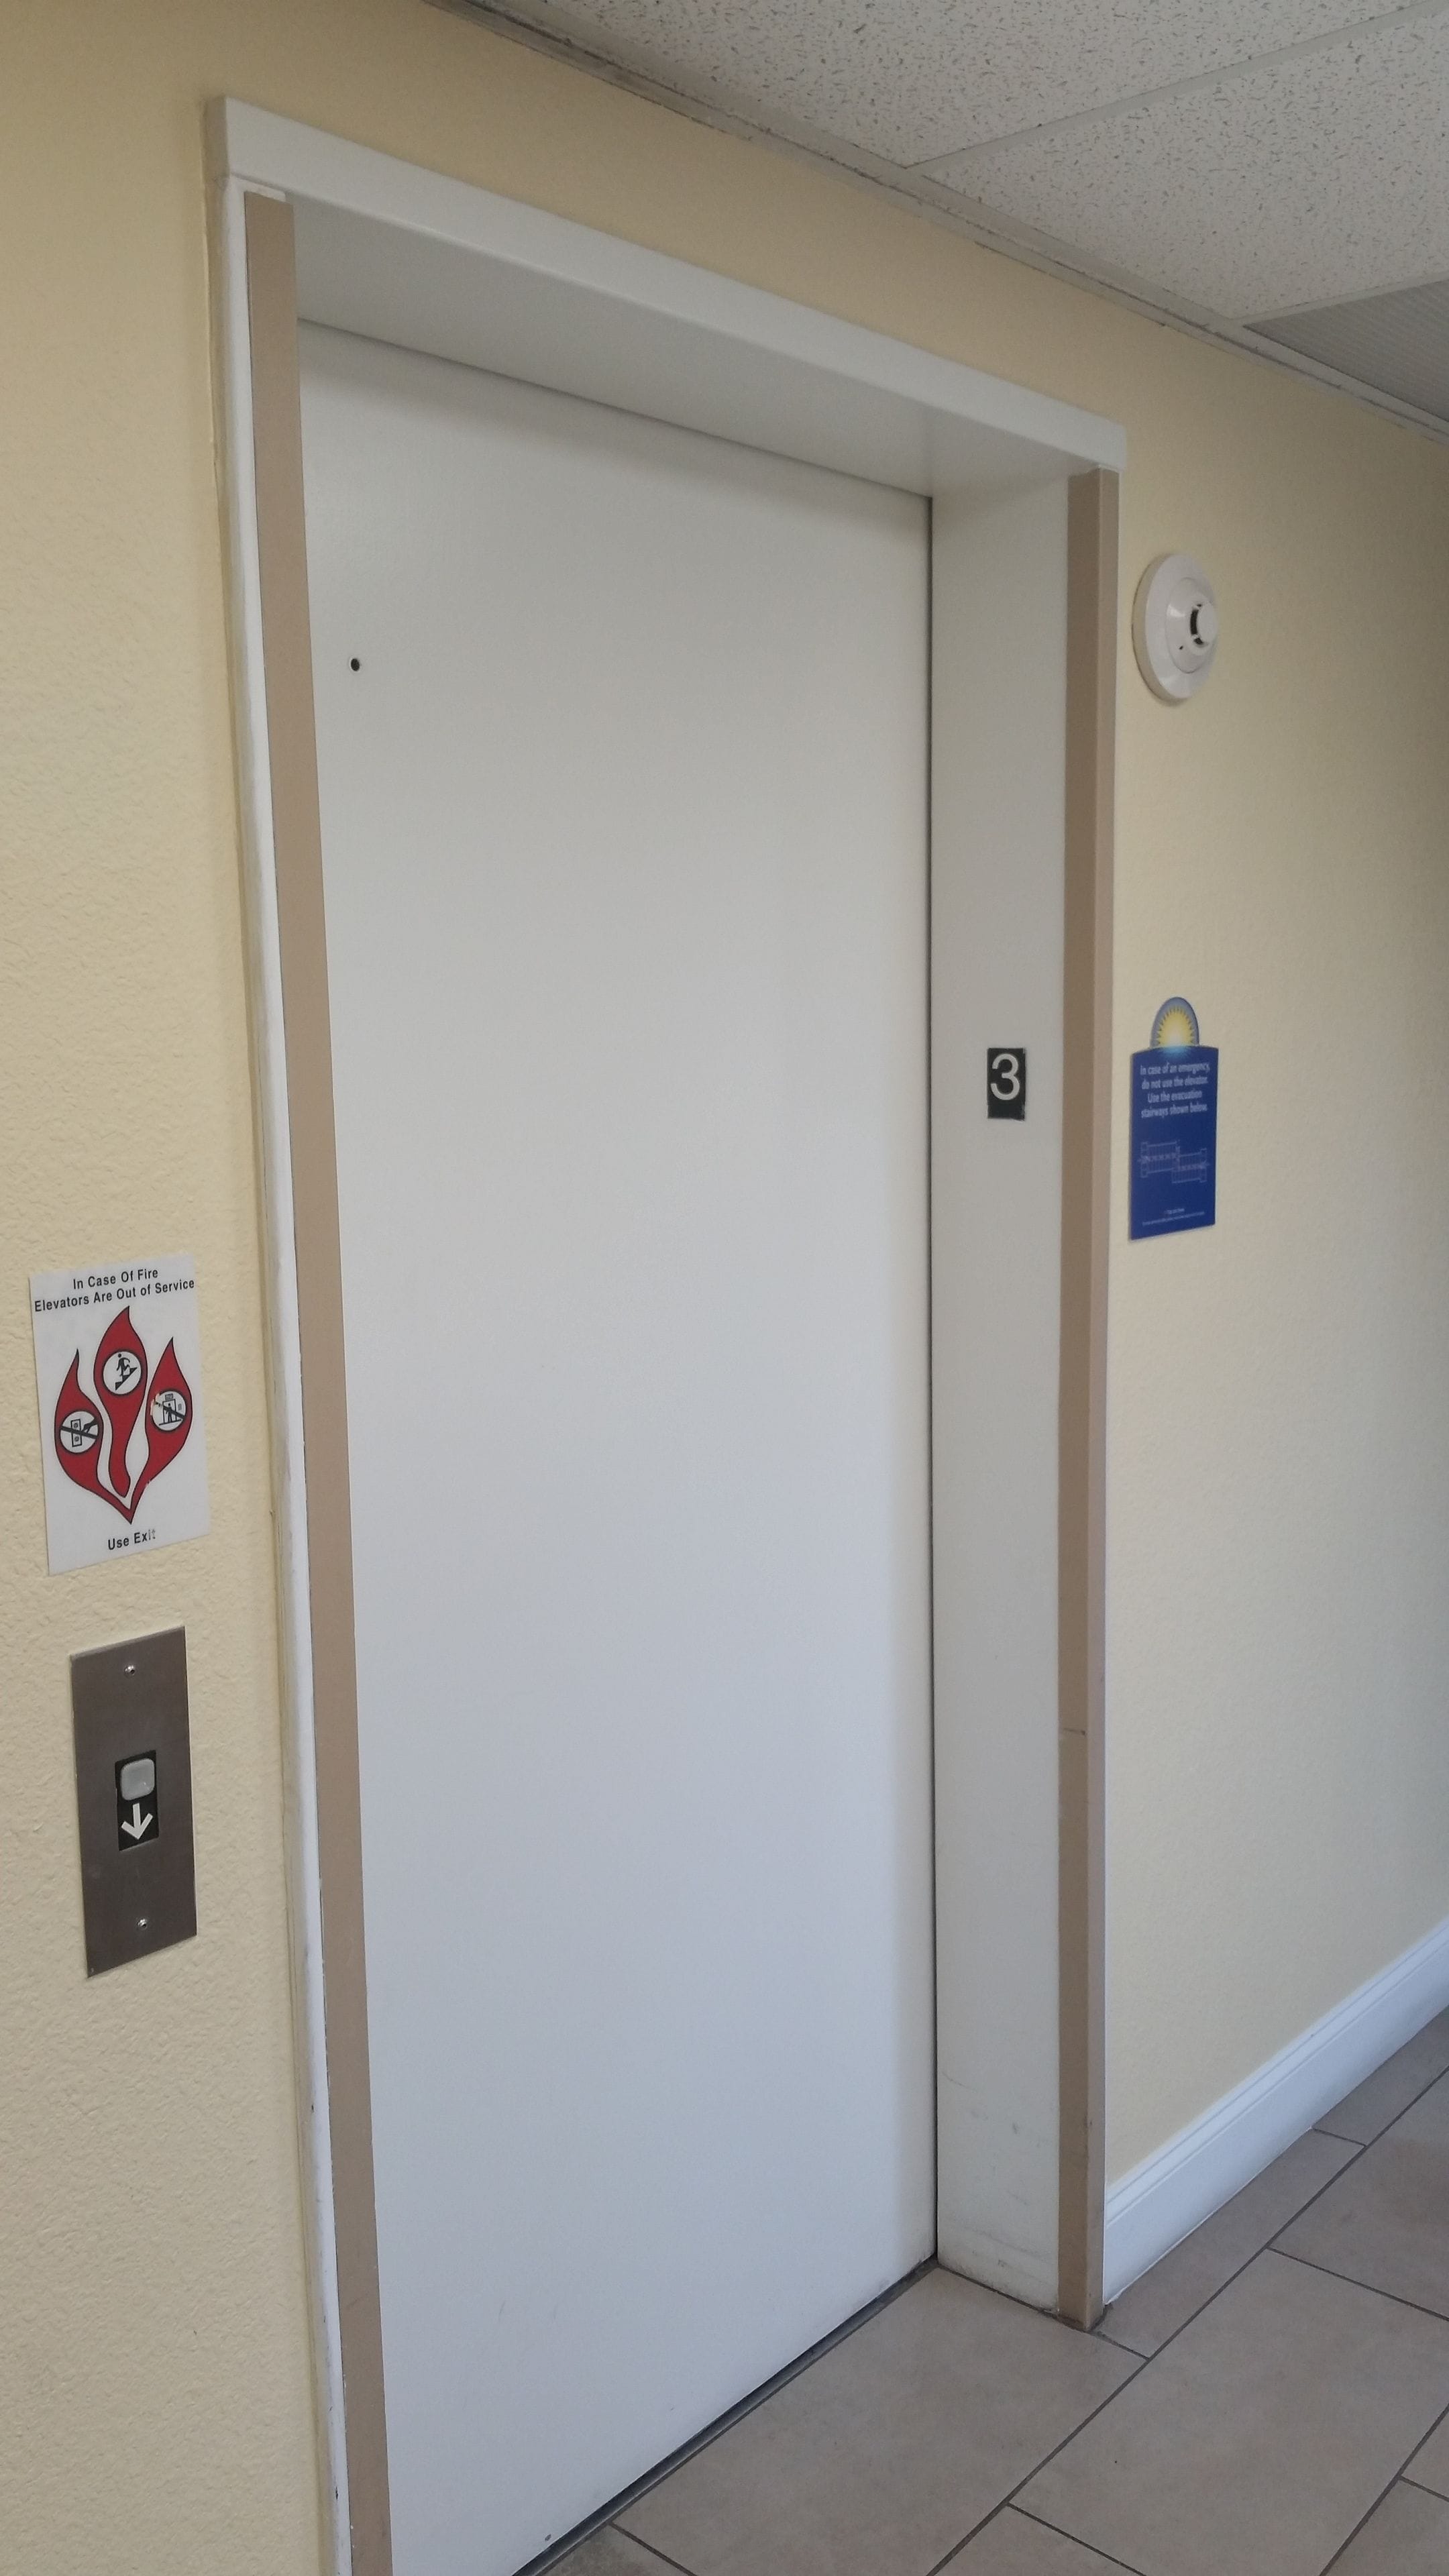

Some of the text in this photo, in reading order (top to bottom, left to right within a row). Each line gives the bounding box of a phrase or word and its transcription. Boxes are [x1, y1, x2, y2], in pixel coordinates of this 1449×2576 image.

[1140, 1065, 1146, 1075] In
[1148, 1067, 1161, 1075] case
[1162, 1061, 1170, 1073] of
[1170, 1065, 1177, 1073] an
[991, 1053, 1020, 1100] 3
[1142, 1079, 1150, 1089] do
[1150, 1079, 1161, 1088] not
[1162, 1079, 1173, 1087] use
[1174, 1076, 1183, 1087] the
[1148, 1089, 1202, 1103] Use the evacuation
[1141, 1106, 1169, 1118] stairways
[1169, 1104, 1189, 1115] shown
[73, 1269, 158, 1289] In Case Of Fire
[34, 1279, 195, 1312] Elevators Are Out of Service
[108, 1538, 129, 1550] Use
